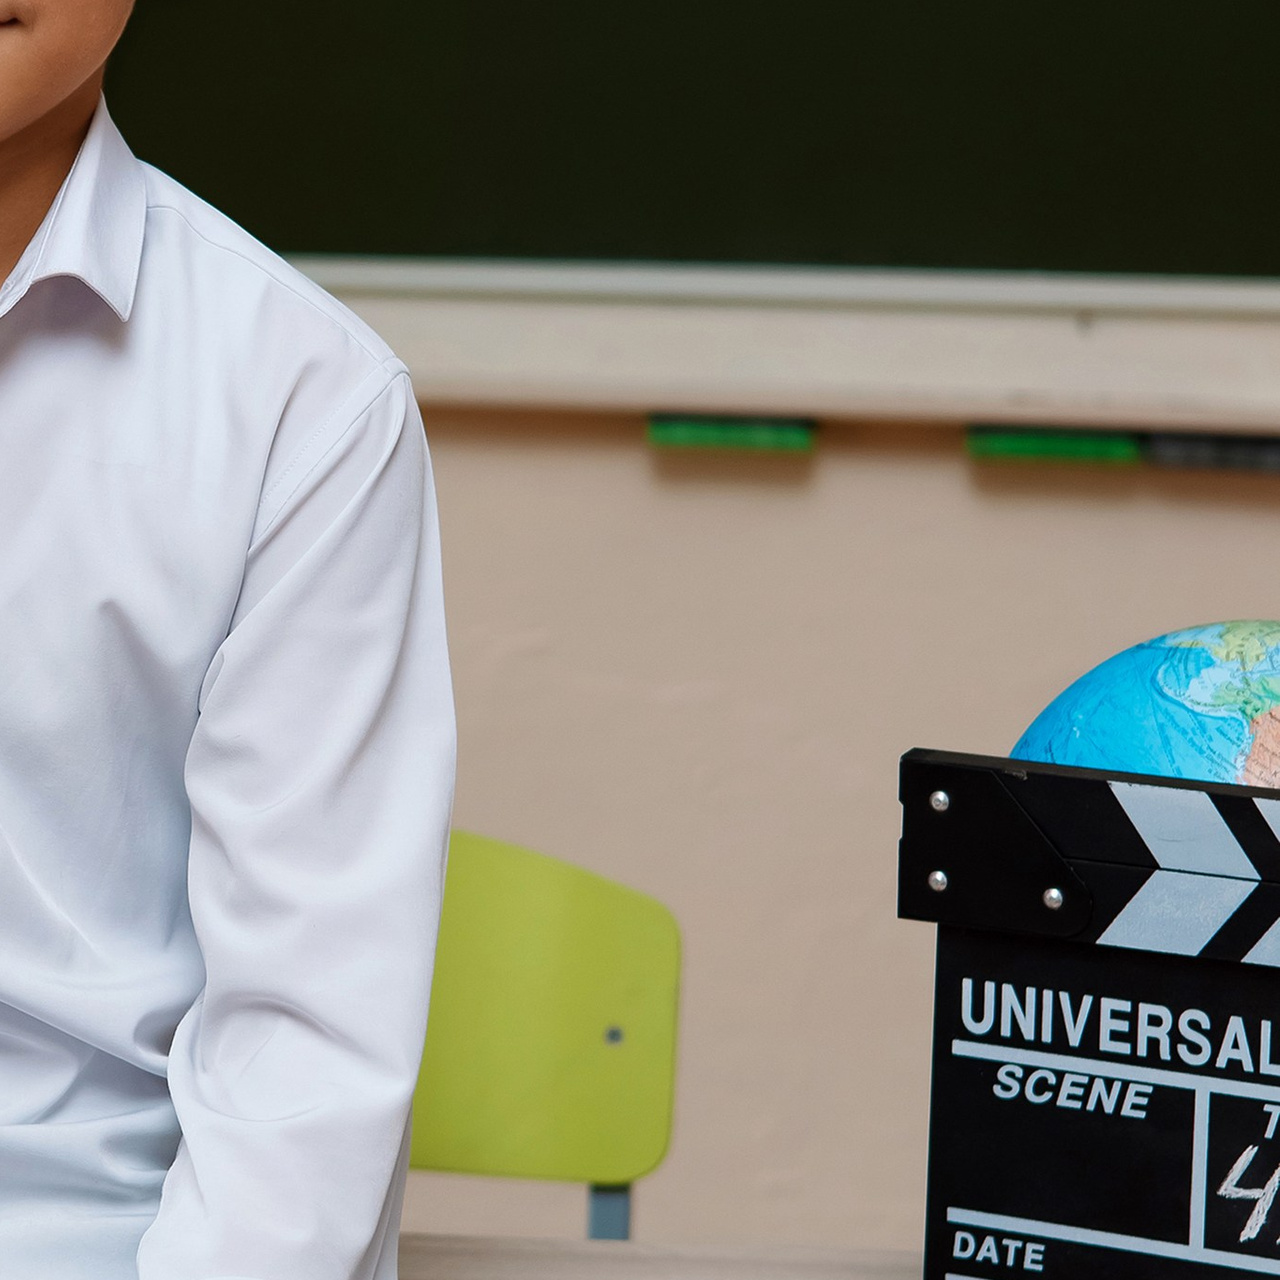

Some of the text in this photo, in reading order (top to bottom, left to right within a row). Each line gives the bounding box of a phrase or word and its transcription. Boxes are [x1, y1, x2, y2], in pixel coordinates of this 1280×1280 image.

[961, 977, 1280, 1077] UNIVERSAL
[992, 1064, 1154, 1119] SCENE
[952, 1230, 1046, 1271] DATE
